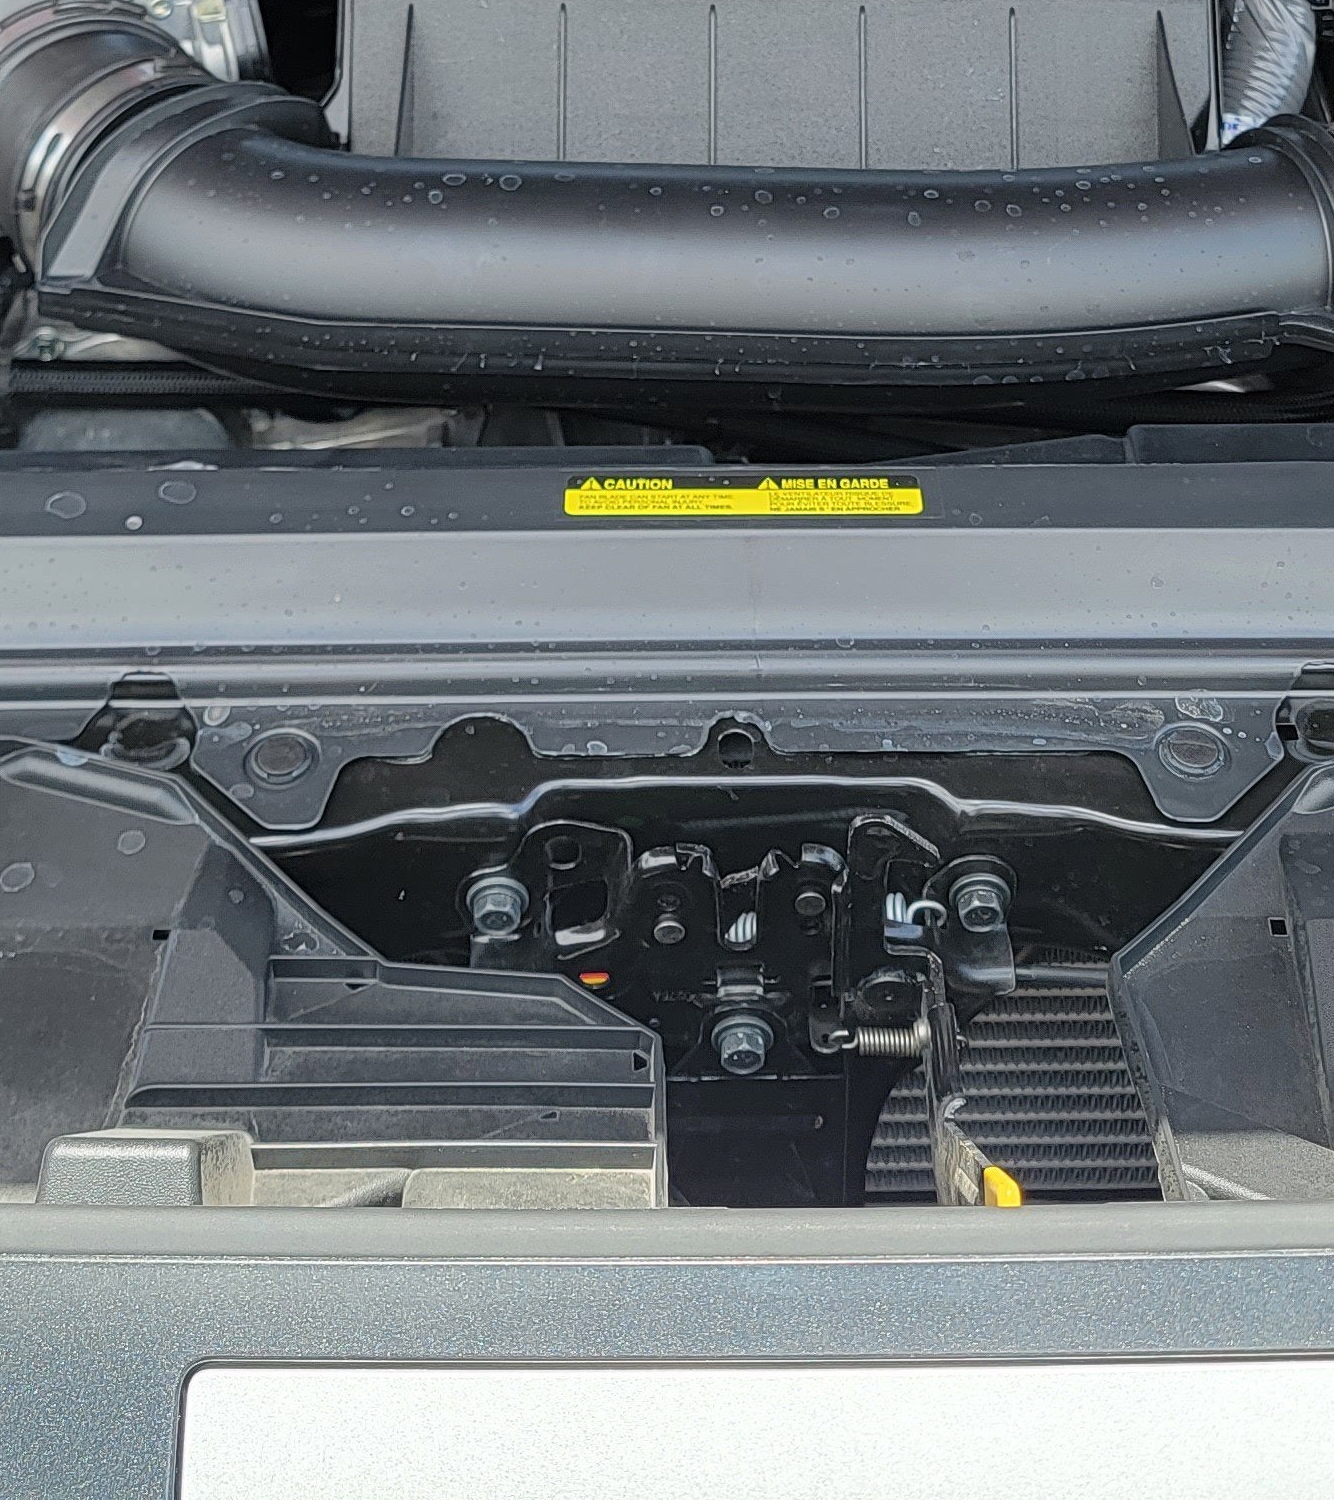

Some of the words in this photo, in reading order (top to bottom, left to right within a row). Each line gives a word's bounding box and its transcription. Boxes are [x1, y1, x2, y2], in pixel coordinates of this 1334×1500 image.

[604, 478, 673, 490] CAUTION
[781, 478, 814, 489] MISE
[817, 478, 837, 489] EN
[839, 478, 889, 489] GARDE
